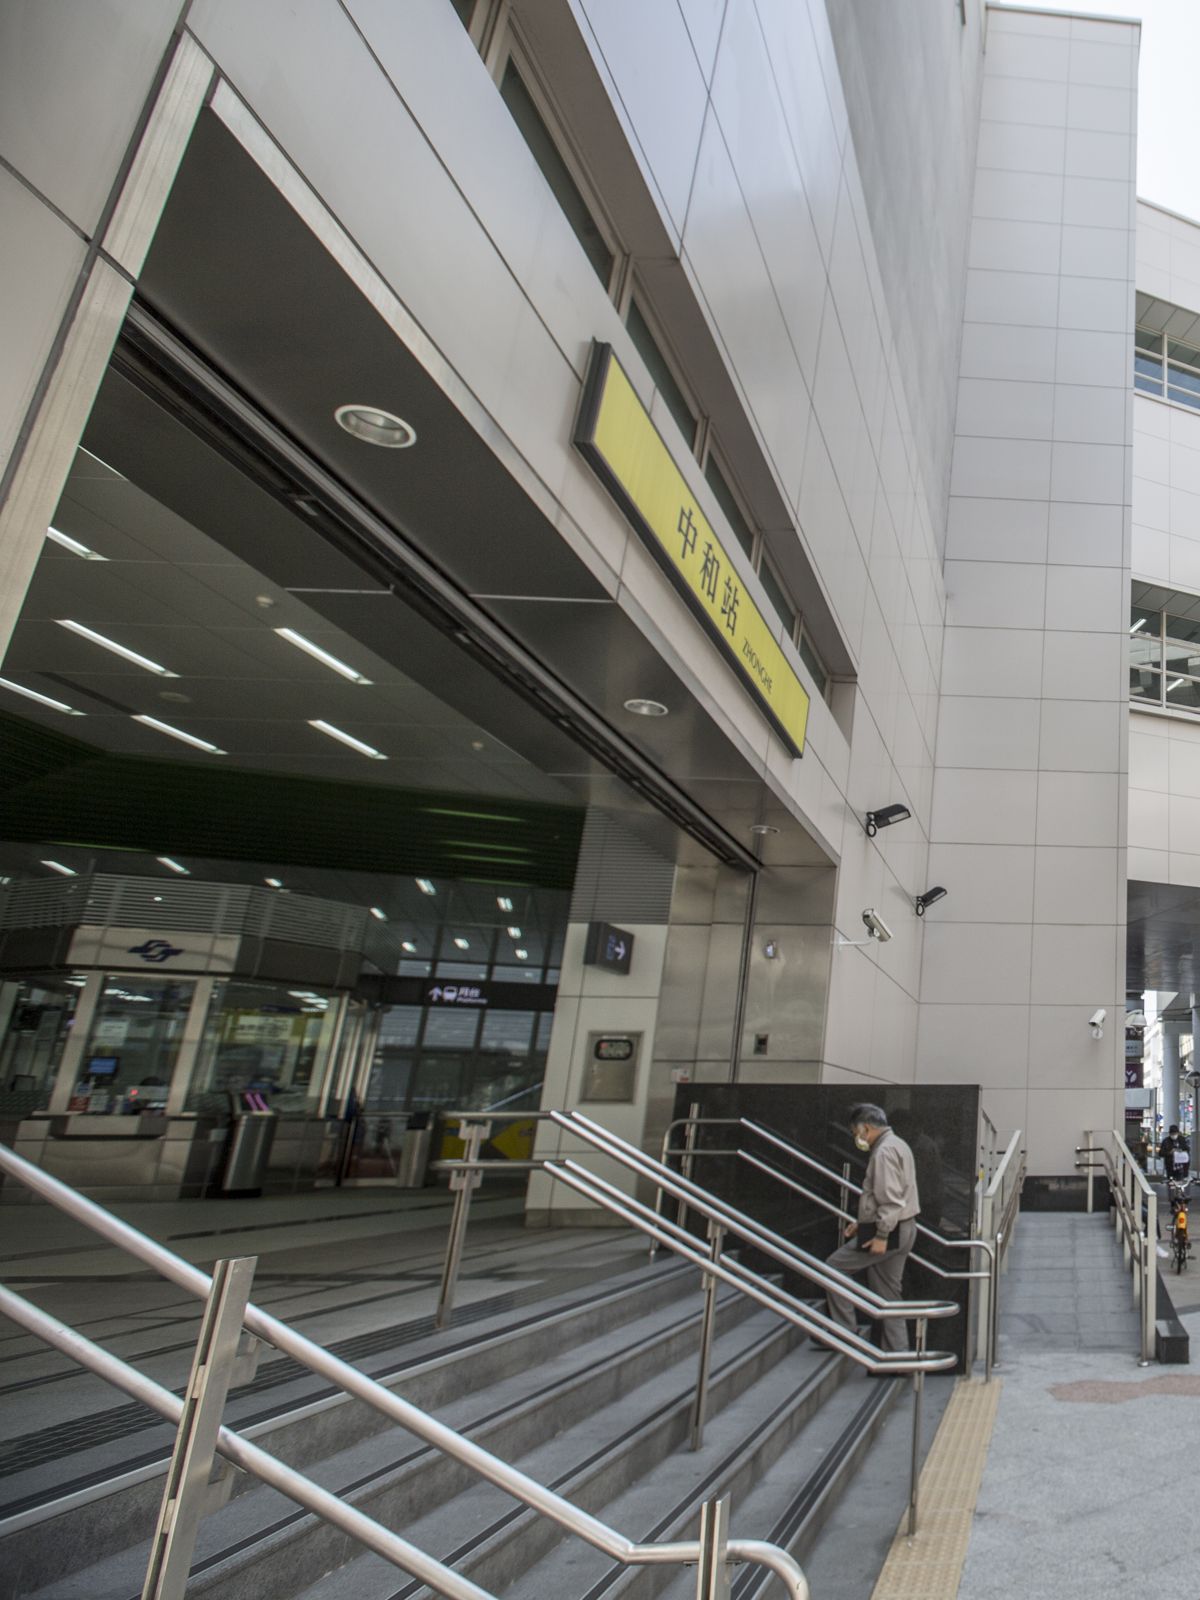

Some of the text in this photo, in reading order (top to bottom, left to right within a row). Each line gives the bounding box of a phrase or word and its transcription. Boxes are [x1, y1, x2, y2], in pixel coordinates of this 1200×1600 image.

[677, 505, 739, 637] 中和站
[742, 635, 773, 695] ZHONGHE
